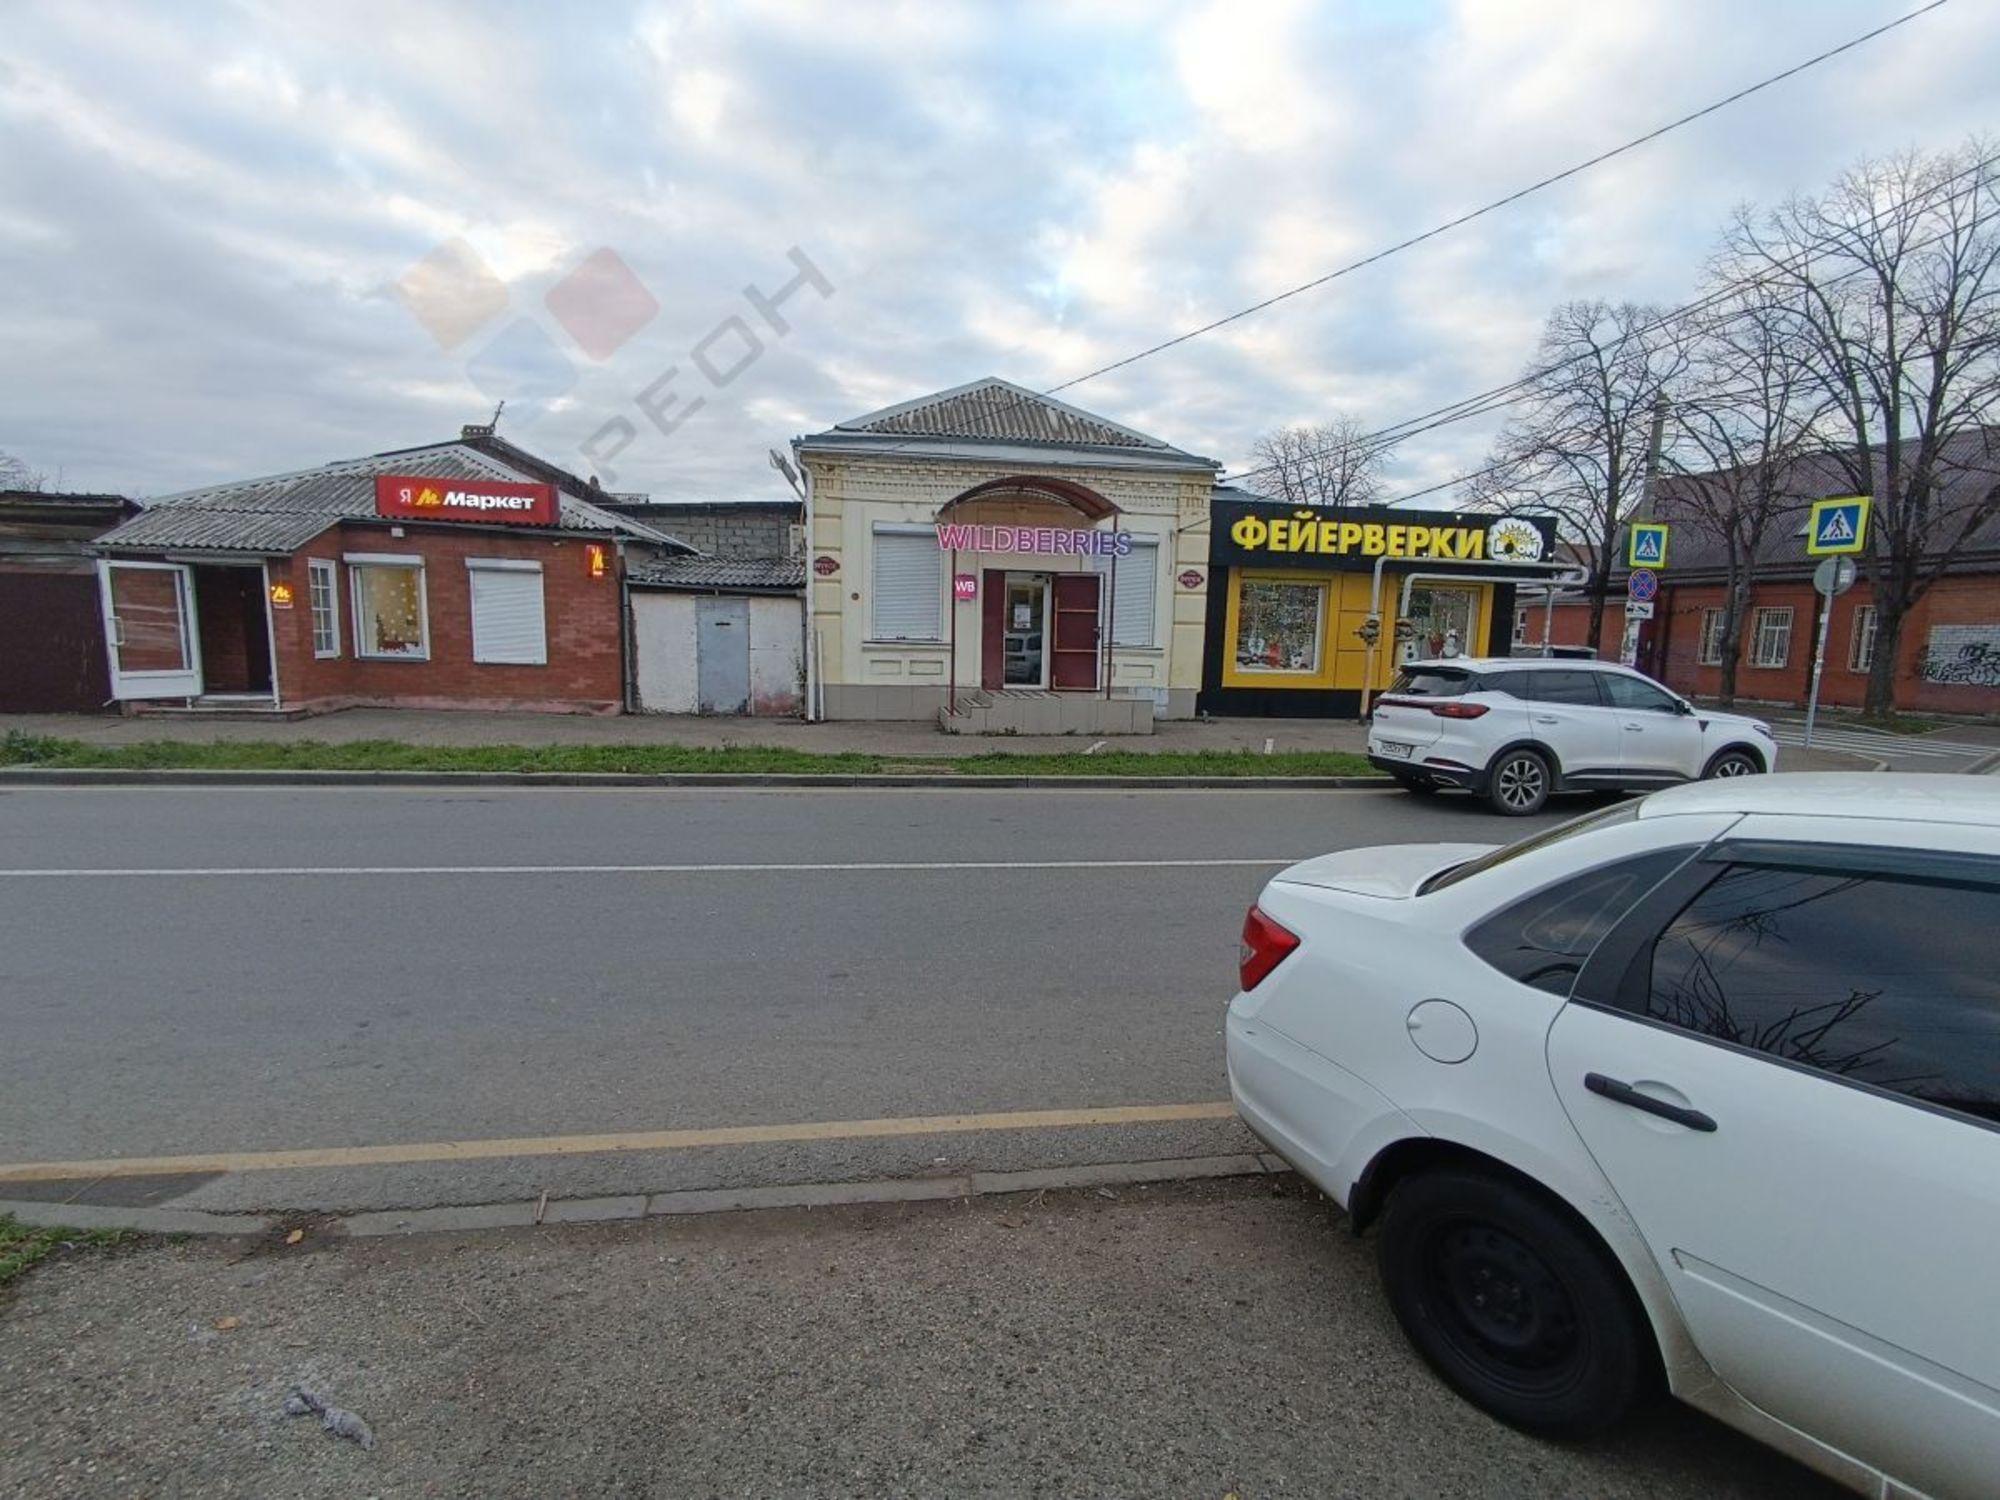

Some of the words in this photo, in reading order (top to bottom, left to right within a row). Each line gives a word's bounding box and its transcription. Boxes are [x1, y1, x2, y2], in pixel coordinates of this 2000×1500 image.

[443, 491, 535, 510] Маркет
[936, 523, 1133, 557] WILDBERRIES
[1231, 510, 1484, 560] ФЕЙЕРВЕРКИ
[955, 580, 975, 592] WB
